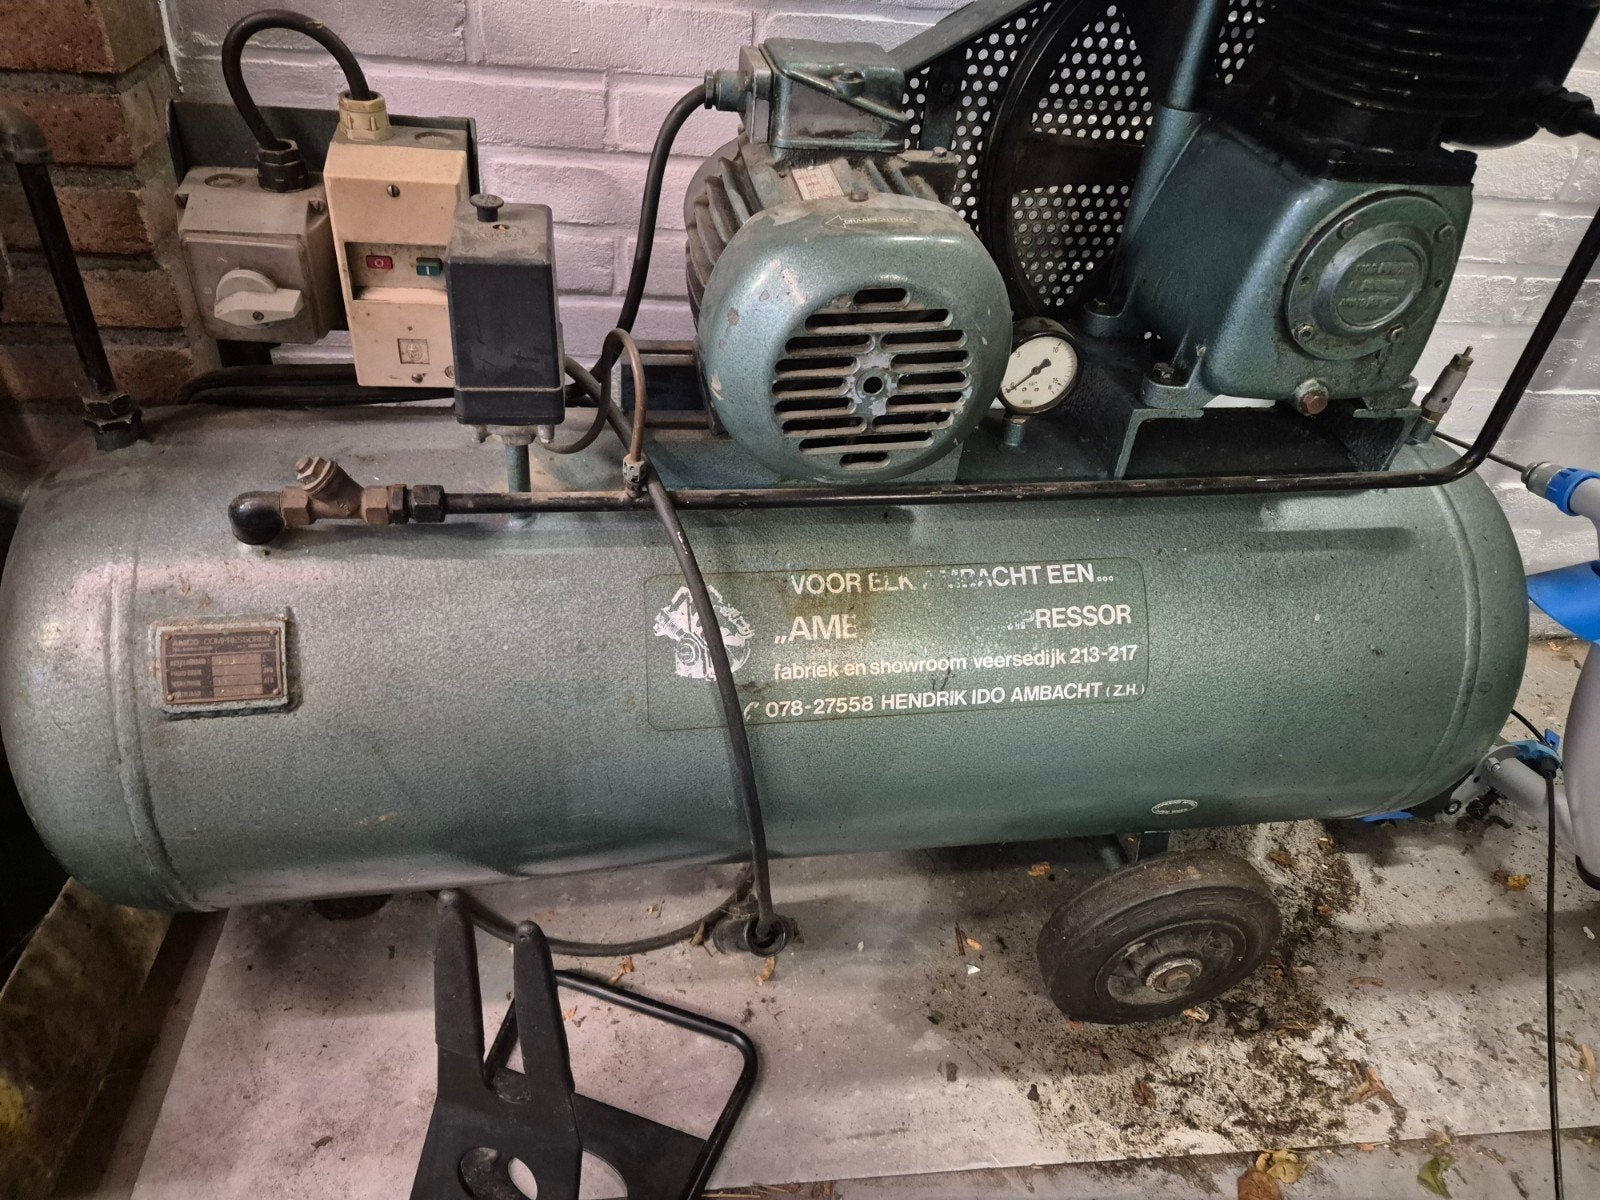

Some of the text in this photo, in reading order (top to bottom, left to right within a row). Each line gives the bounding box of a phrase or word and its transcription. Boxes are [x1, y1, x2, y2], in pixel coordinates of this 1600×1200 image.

[790, 572, 862, 595] VOOR
[773, 644, 1138, 680] fabriek en showroom veersedijk 213-217
[765, 695, 874, 719] 078-27558
[880, 690, 968, 710] HENDRIK
[971, 686, 1006, 705] IDO
[1010, 682, 1103, 703] AMBACHT
